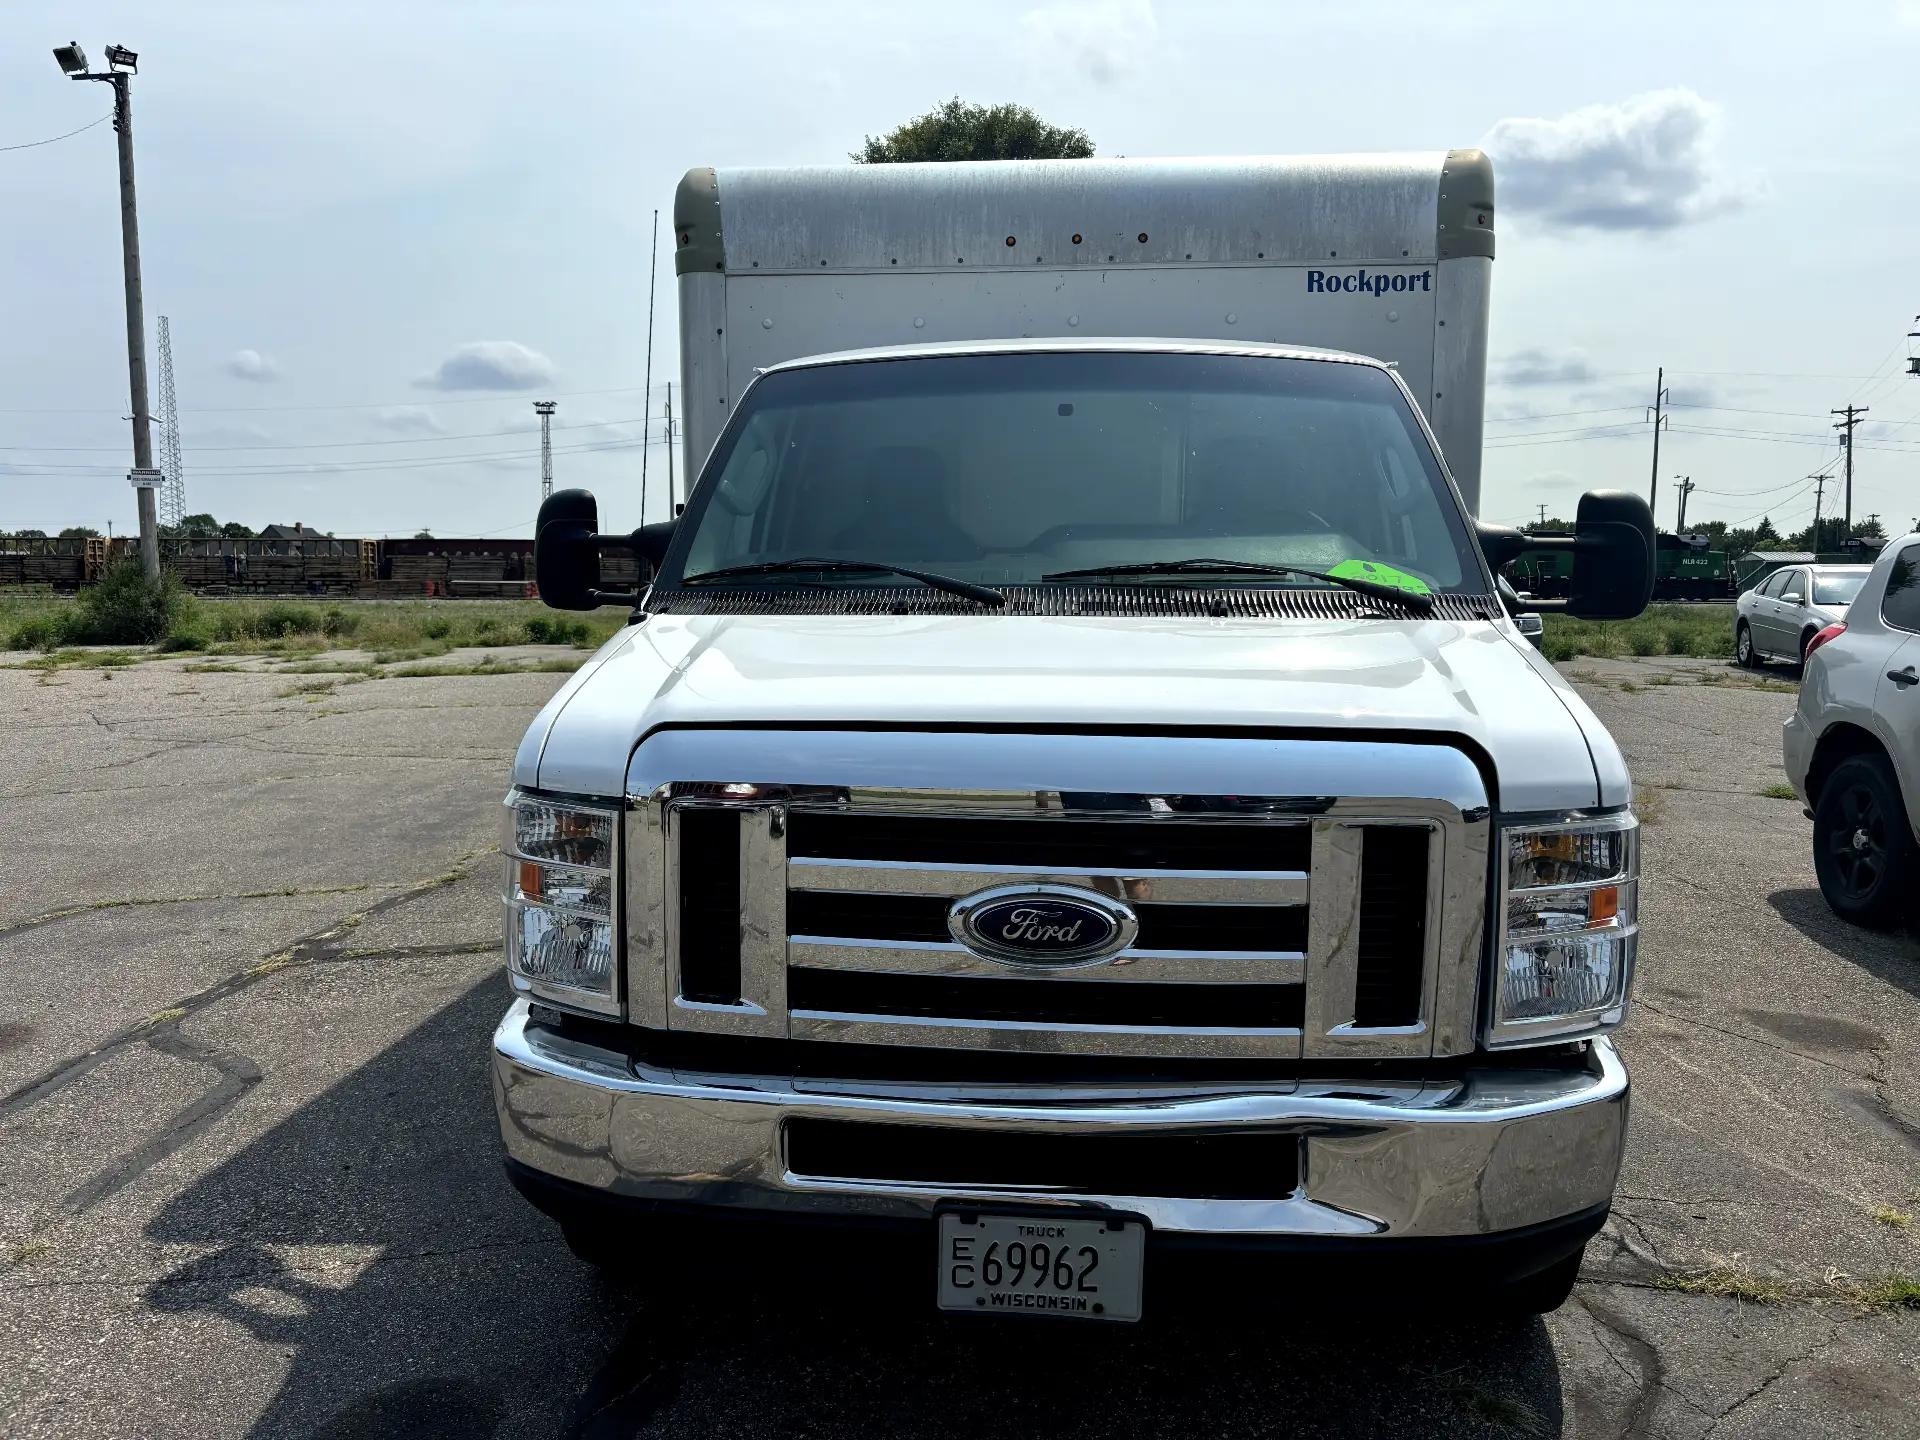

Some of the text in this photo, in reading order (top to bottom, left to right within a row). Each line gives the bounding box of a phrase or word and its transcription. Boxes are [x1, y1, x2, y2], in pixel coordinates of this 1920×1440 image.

[1307, 269, 1432, 297] Rockport
[1002, 908, 1083, 942] Ford
[1018, 1225, 1066, 1238] TRUCK
[982, 1240, 1099, 1292] 69962
[990, 1292, 1087, 1311] WISCONSIN
